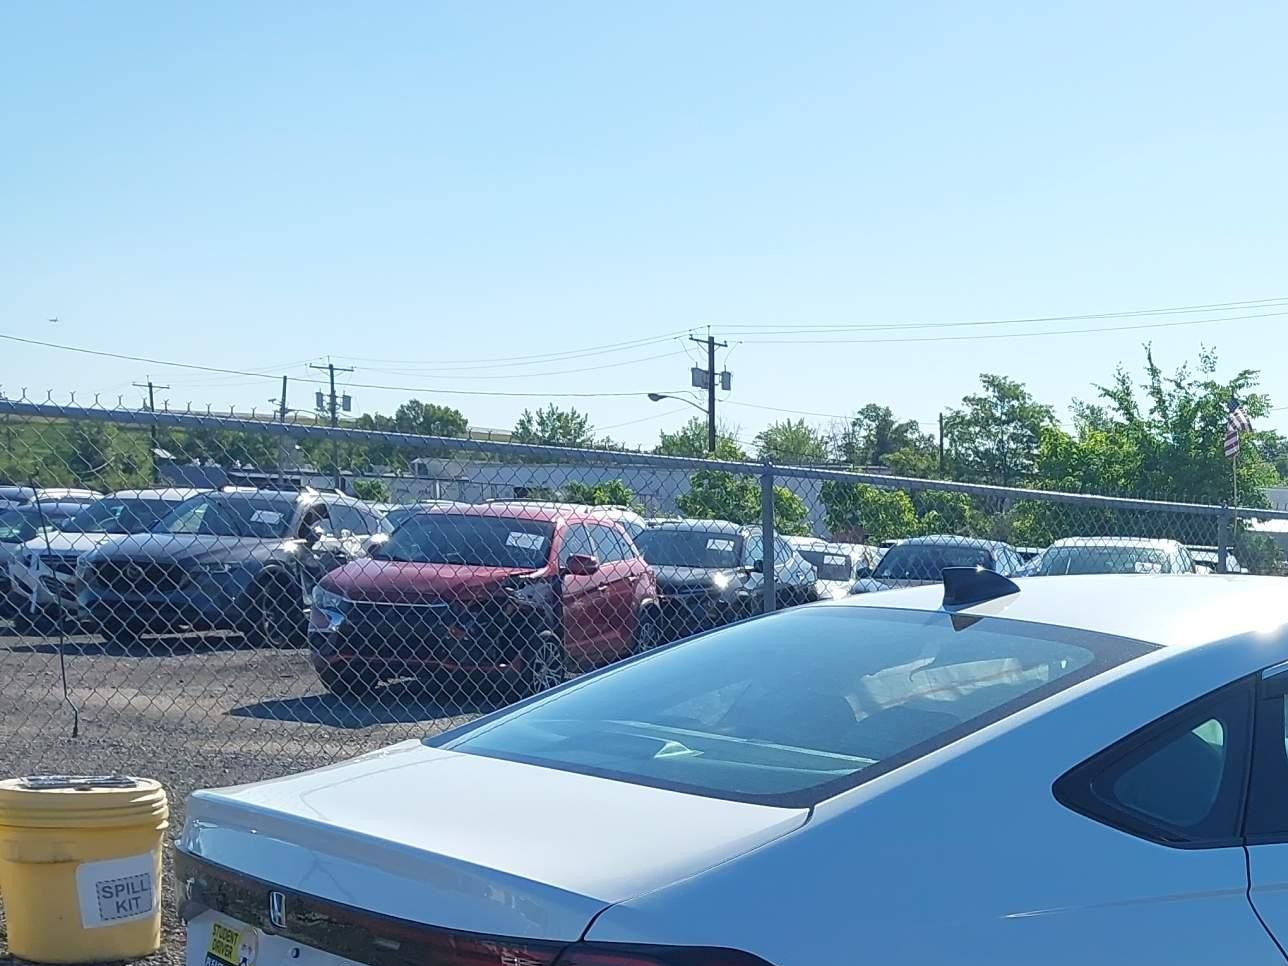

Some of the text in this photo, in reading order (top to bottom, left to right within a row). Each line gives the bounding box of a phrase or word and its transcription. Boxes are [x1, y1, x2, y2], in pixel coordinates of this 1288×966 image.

[102, 880, 148, 899] SPILL
[116, 896, 141, 914] KIT
[212, 923, 239, 945] STUDENT
[211, 938, 233, 959] DRIVER
